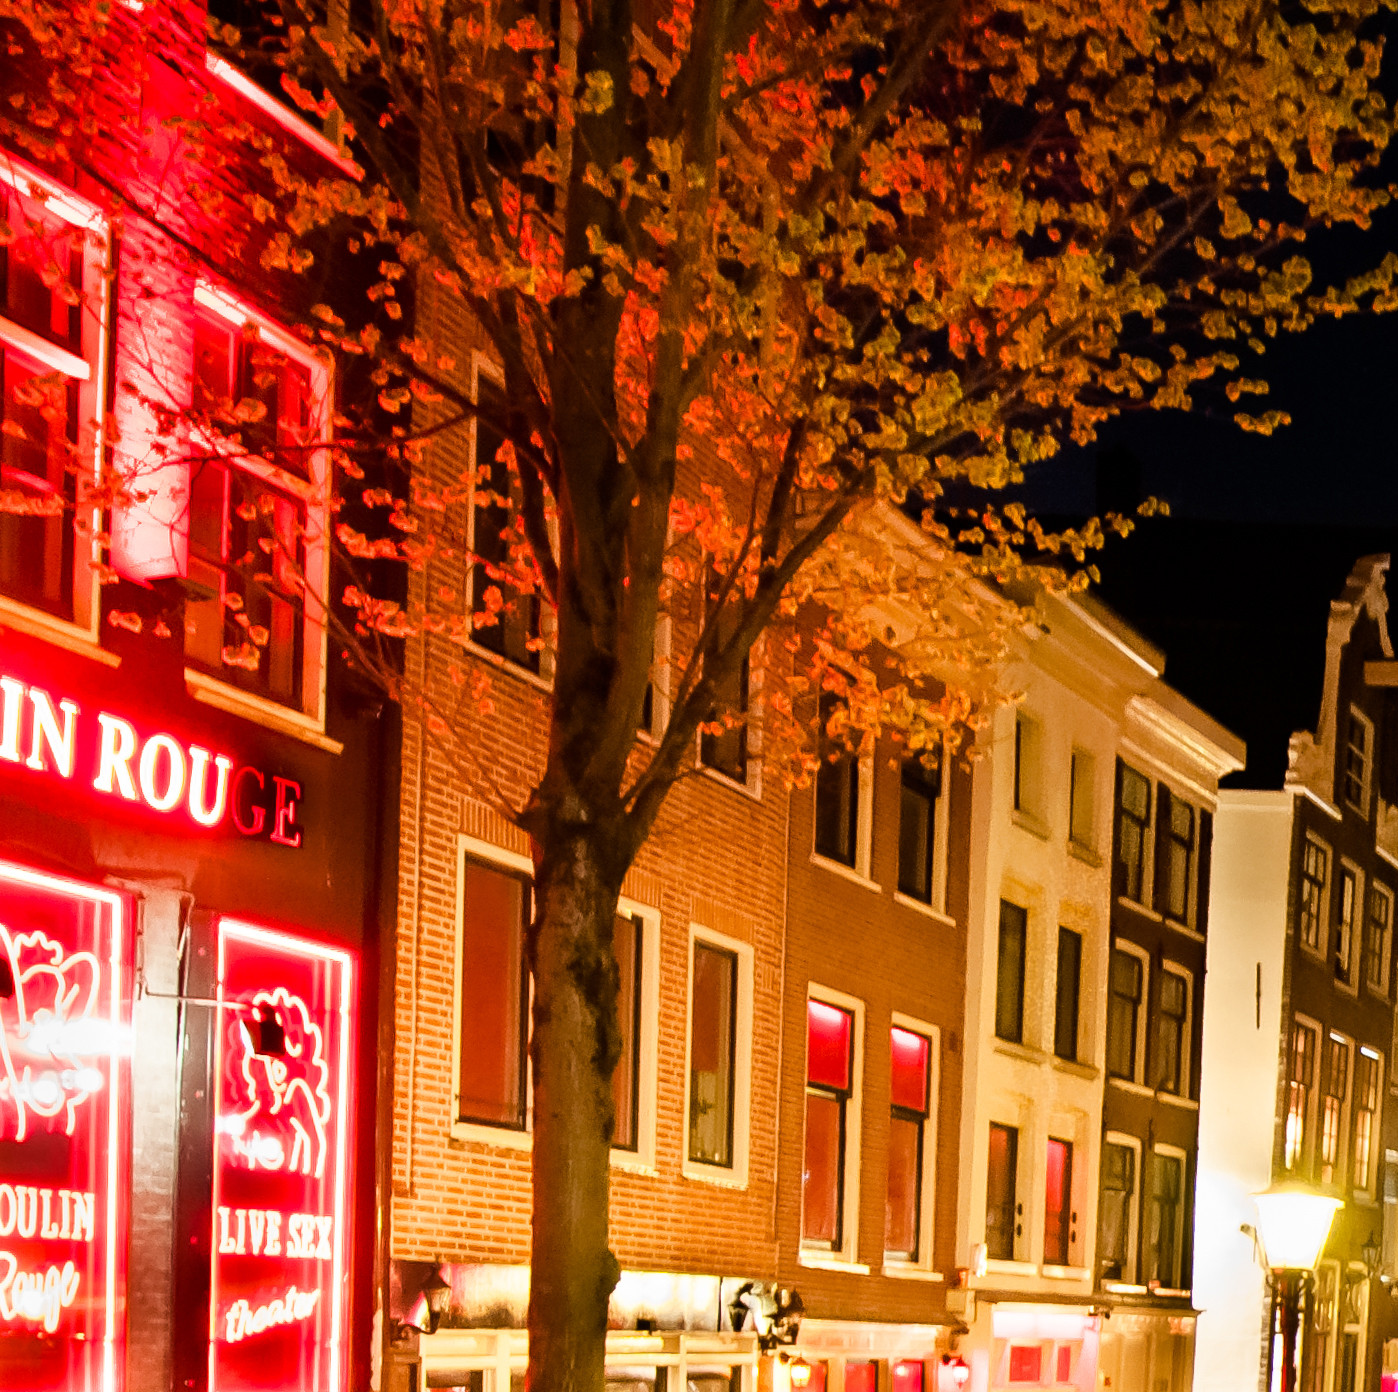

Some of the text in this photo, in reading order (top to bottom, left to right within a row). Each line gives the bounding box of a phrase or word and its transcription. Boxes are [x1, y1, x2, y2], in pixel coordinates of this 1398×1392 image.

[93, 711, 301, 848] ROUGE
[217, 1206, 332, 1260] LIVE SEX
